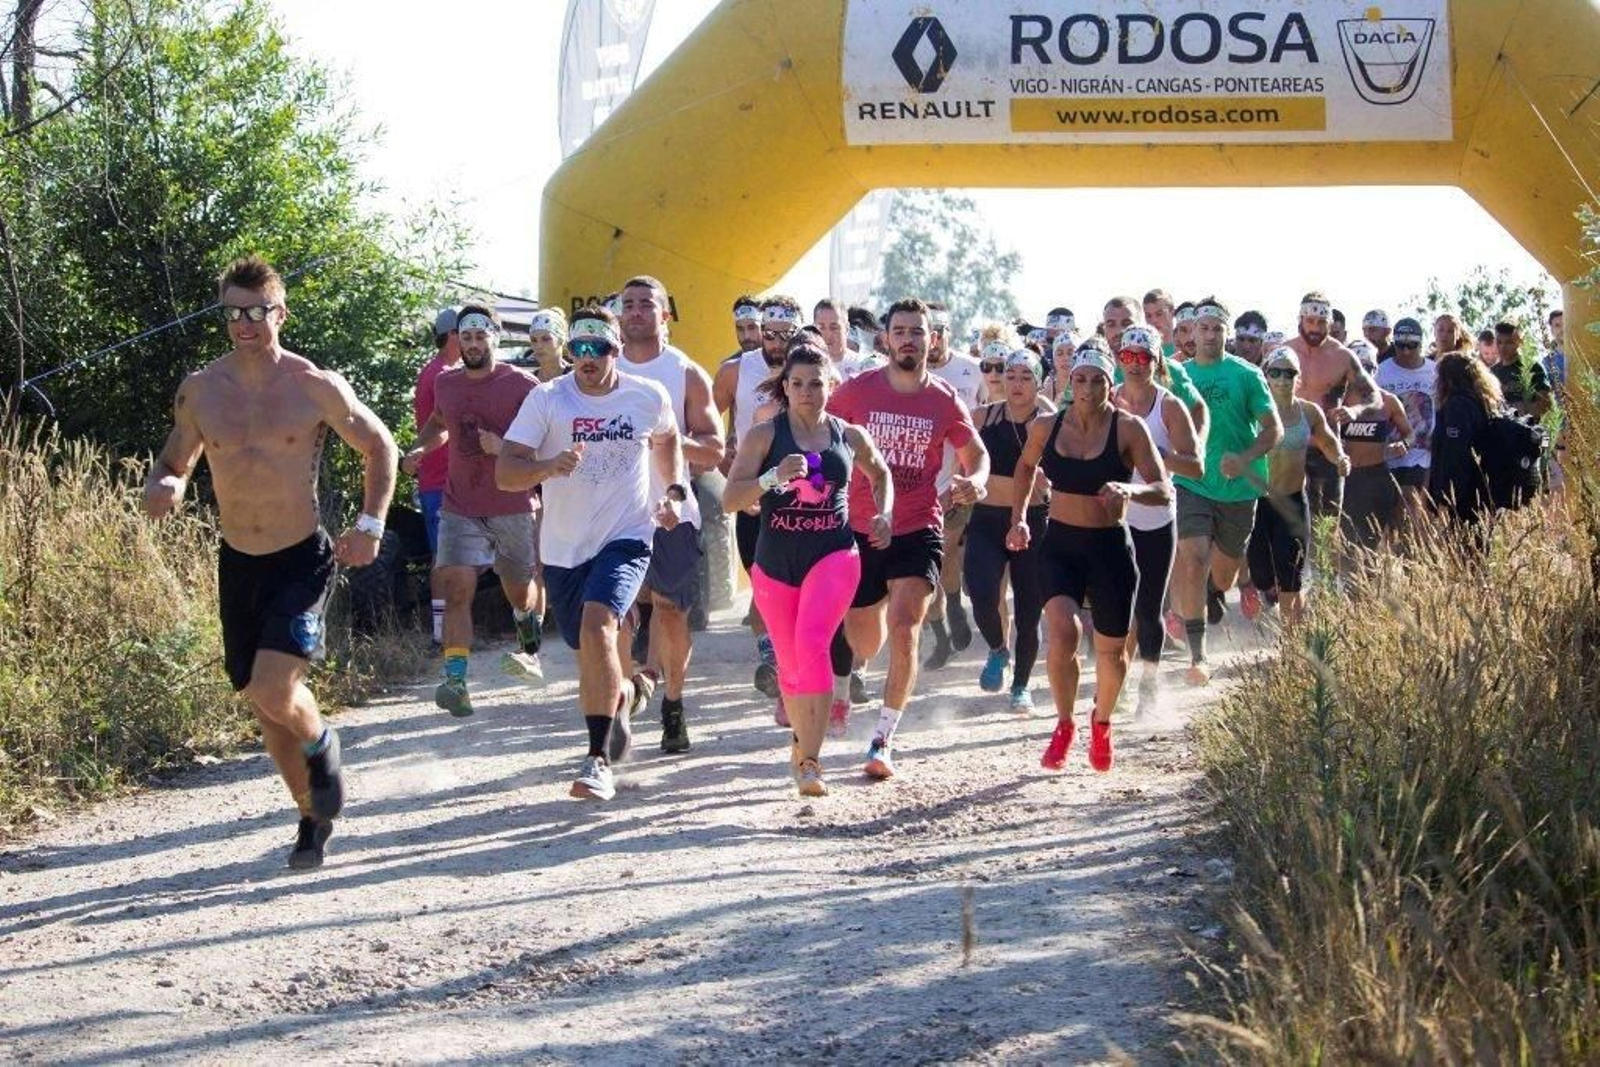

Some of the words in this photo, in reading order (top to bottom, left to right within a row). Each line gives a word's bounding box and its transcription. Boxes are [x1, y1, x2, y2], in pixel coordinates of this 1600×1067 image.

[1009, 12, 1320, 66] RODOSA
[1353, 31, 1417, 45] DACIA
[1009, 78, 1049, 94] VIGO
[1061, 75, 1124, 94] NIGRÁN
[1135, 77, 1202, 94] CANGAS
[1214, 76, 1325, 93] PONTEAREAS
[858, 100, 996, 121] RENAULT
[1056, 105, 1280, 125] www.rodosa.com
[572, 417, 606, 432] FSC
[868, 411, 934, 431] THRUSTERS
[1345, 422, 1378, 437] NIKE
[572, 430, 634, 442] TRAINING
[866, 422, 933, 445] BURPEES
[881, 449, 926, 469] ATCH
